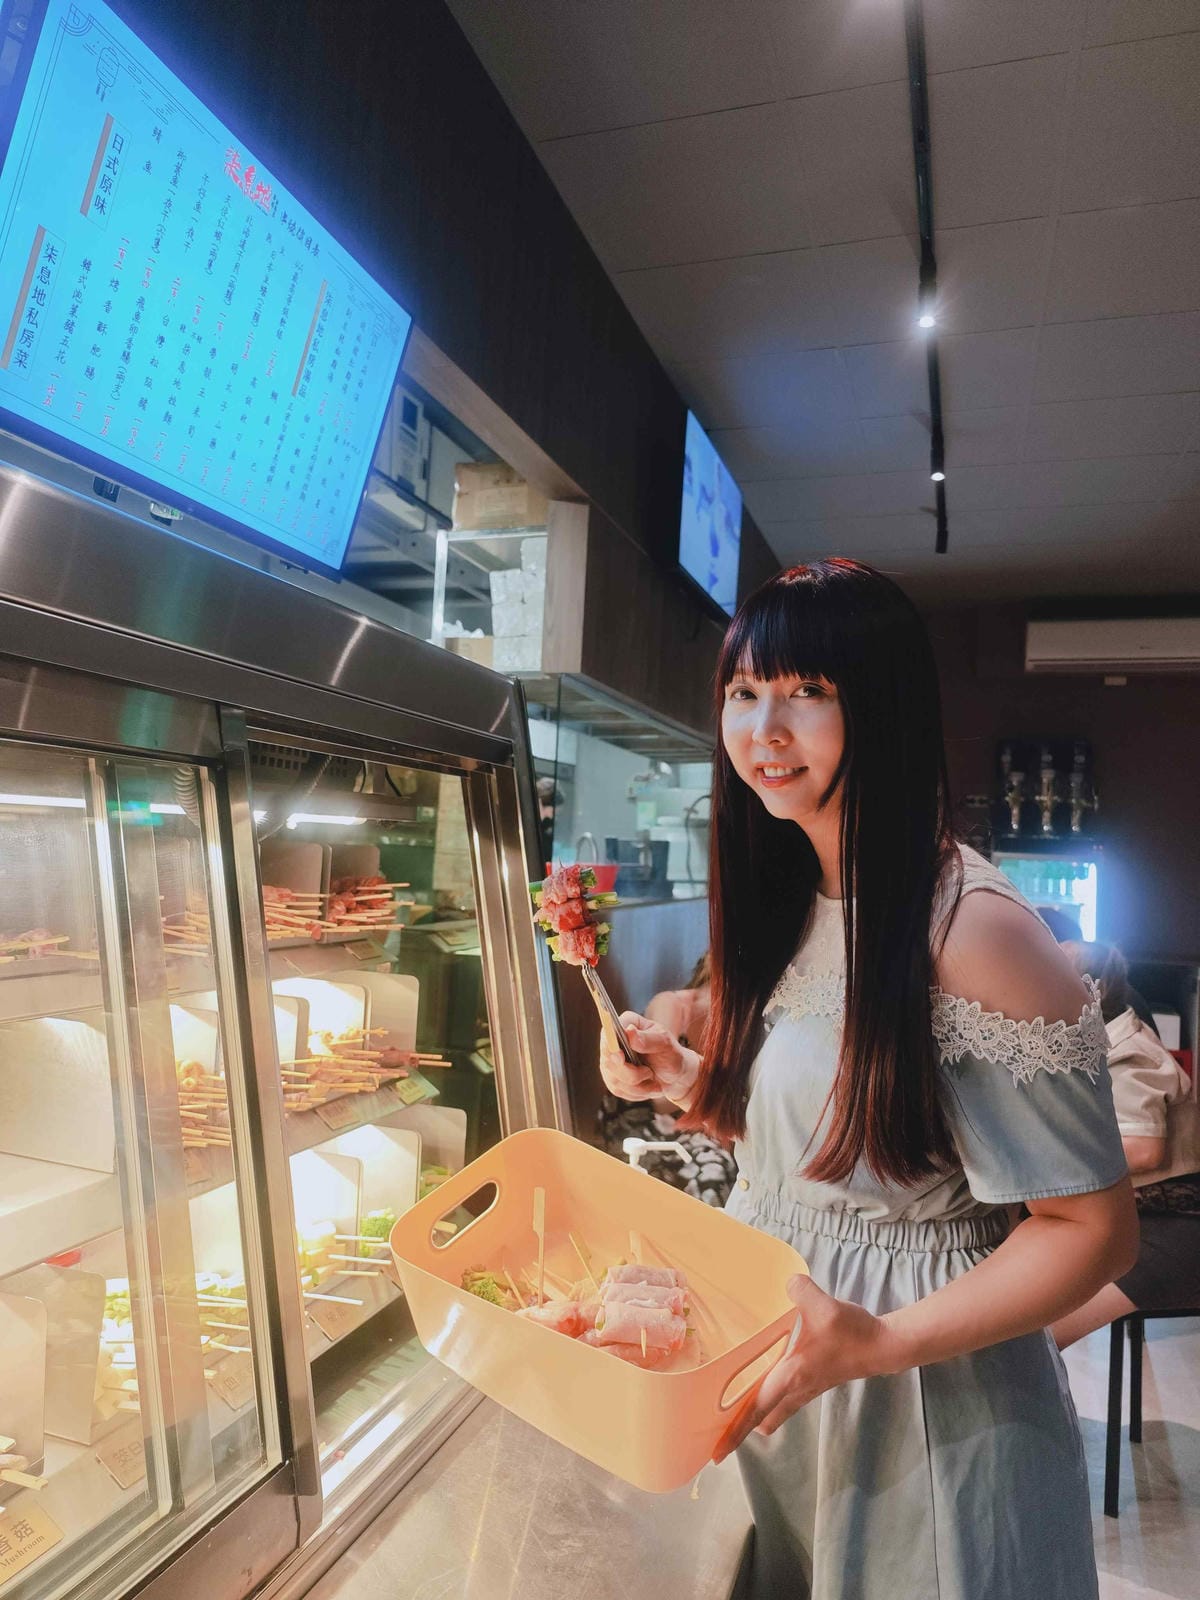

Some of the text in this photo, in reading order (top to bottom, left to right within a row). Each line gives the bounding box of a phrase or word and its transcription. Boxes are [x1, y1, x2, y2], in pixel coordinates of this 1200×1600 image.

[94, 133, 124, 215] 日式原味
[14, 243, 57, 369] 柒息地私房菜
[42, 257, 92, 407] 韓式泡菜豬五花 一七五
[84, 278, 119, 380] 烤香酥肥腸
[110, 295, 145, 400] 飛魚卵香腸(兩支)
